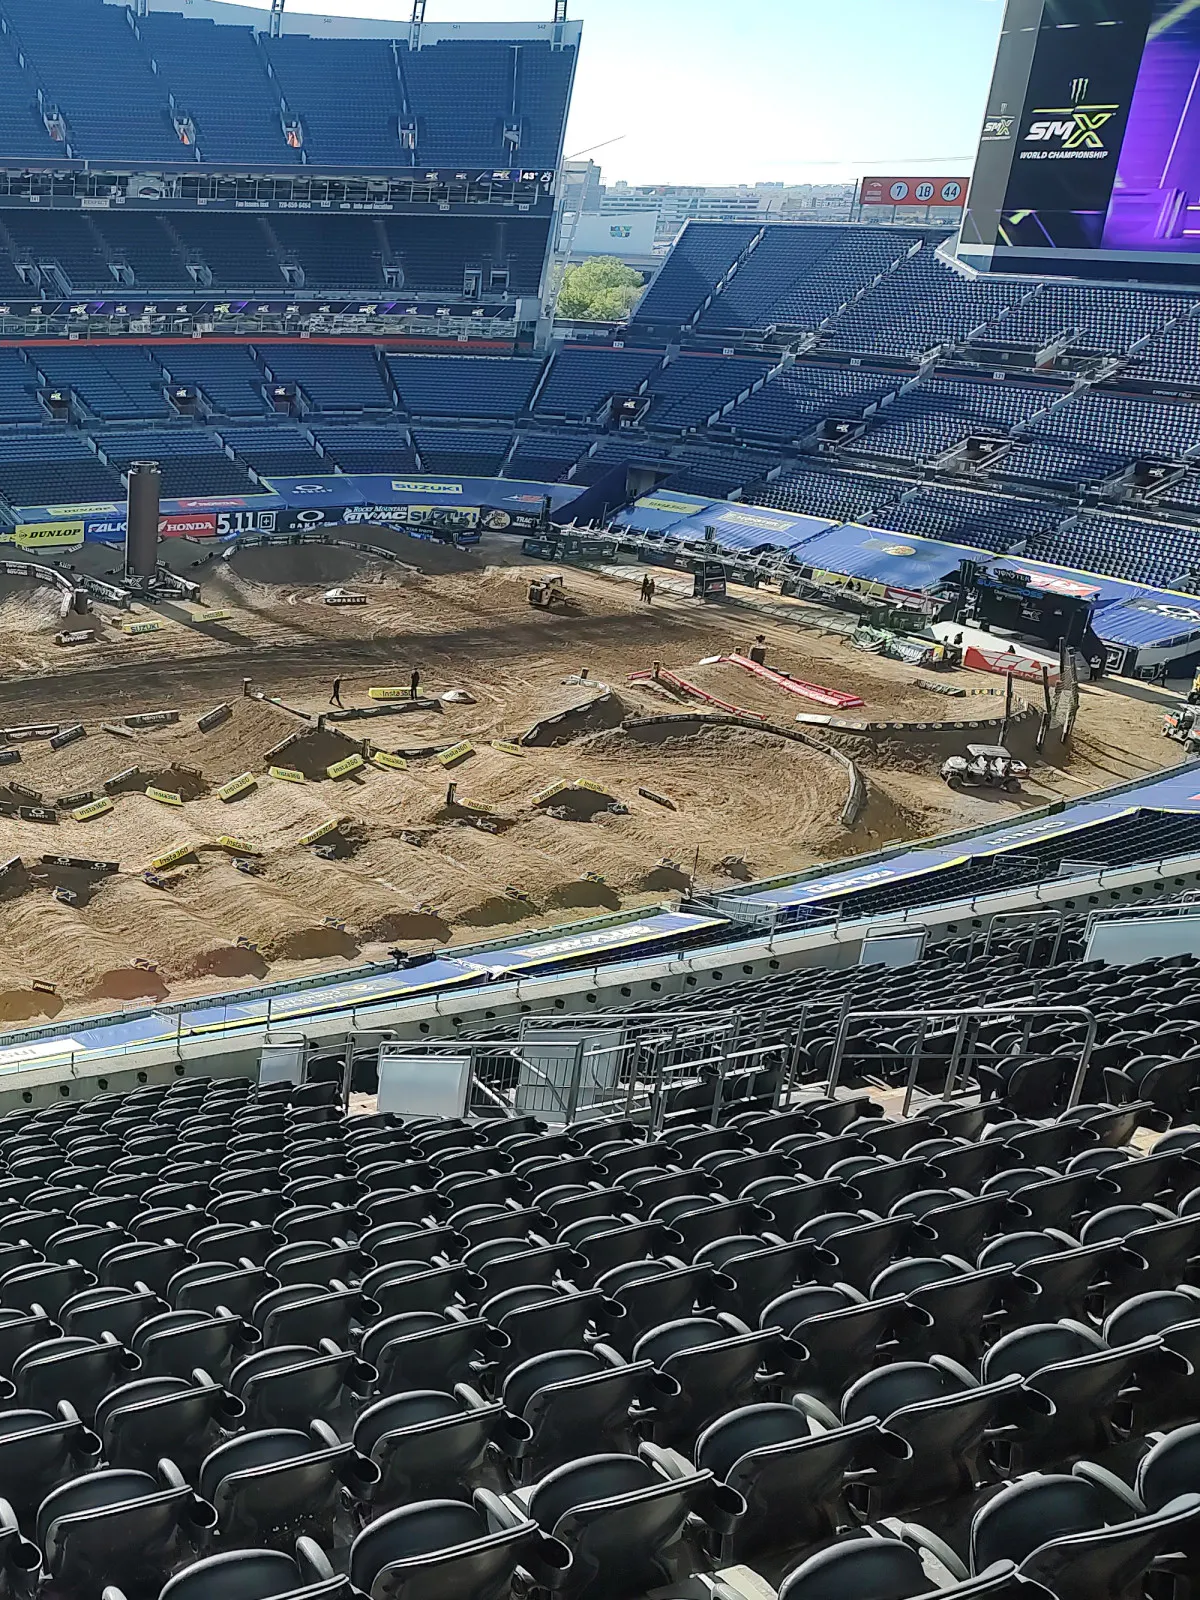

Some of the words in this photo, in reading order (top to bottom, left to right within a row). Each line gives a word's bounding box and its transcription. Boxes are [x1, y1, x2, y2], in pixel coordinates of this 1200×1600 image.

[984, 119, 1014, 136] SMX
[1024, 113, 1114, 149] SMX
[1019, 151, 1047, 160] WORLD
[1048, 150, 1109, 160] CHAMPIONSHIP
[896, 185, 903, 197] 7
[918, 185, 931, 198] 18
[943, 185, 958, 198] 44
[394, 483, 461, 492] SUZUKI
[88, 521, 126, 533] FALK
[166, 520, 214, 532] HONDA
[216, 511, 254, 534] 5.11
[28, 528, 82, 539] DUNLOP
[443, 741, 469, 761] Insta360
[332, 757, 358, 775] Insta360
[222, 775, 251, 797] Insta360
[79, 800, 107, 816] Insta360
[307, 823, 334, 843] Insta360
[158, 846, 189, 867] Insta360
